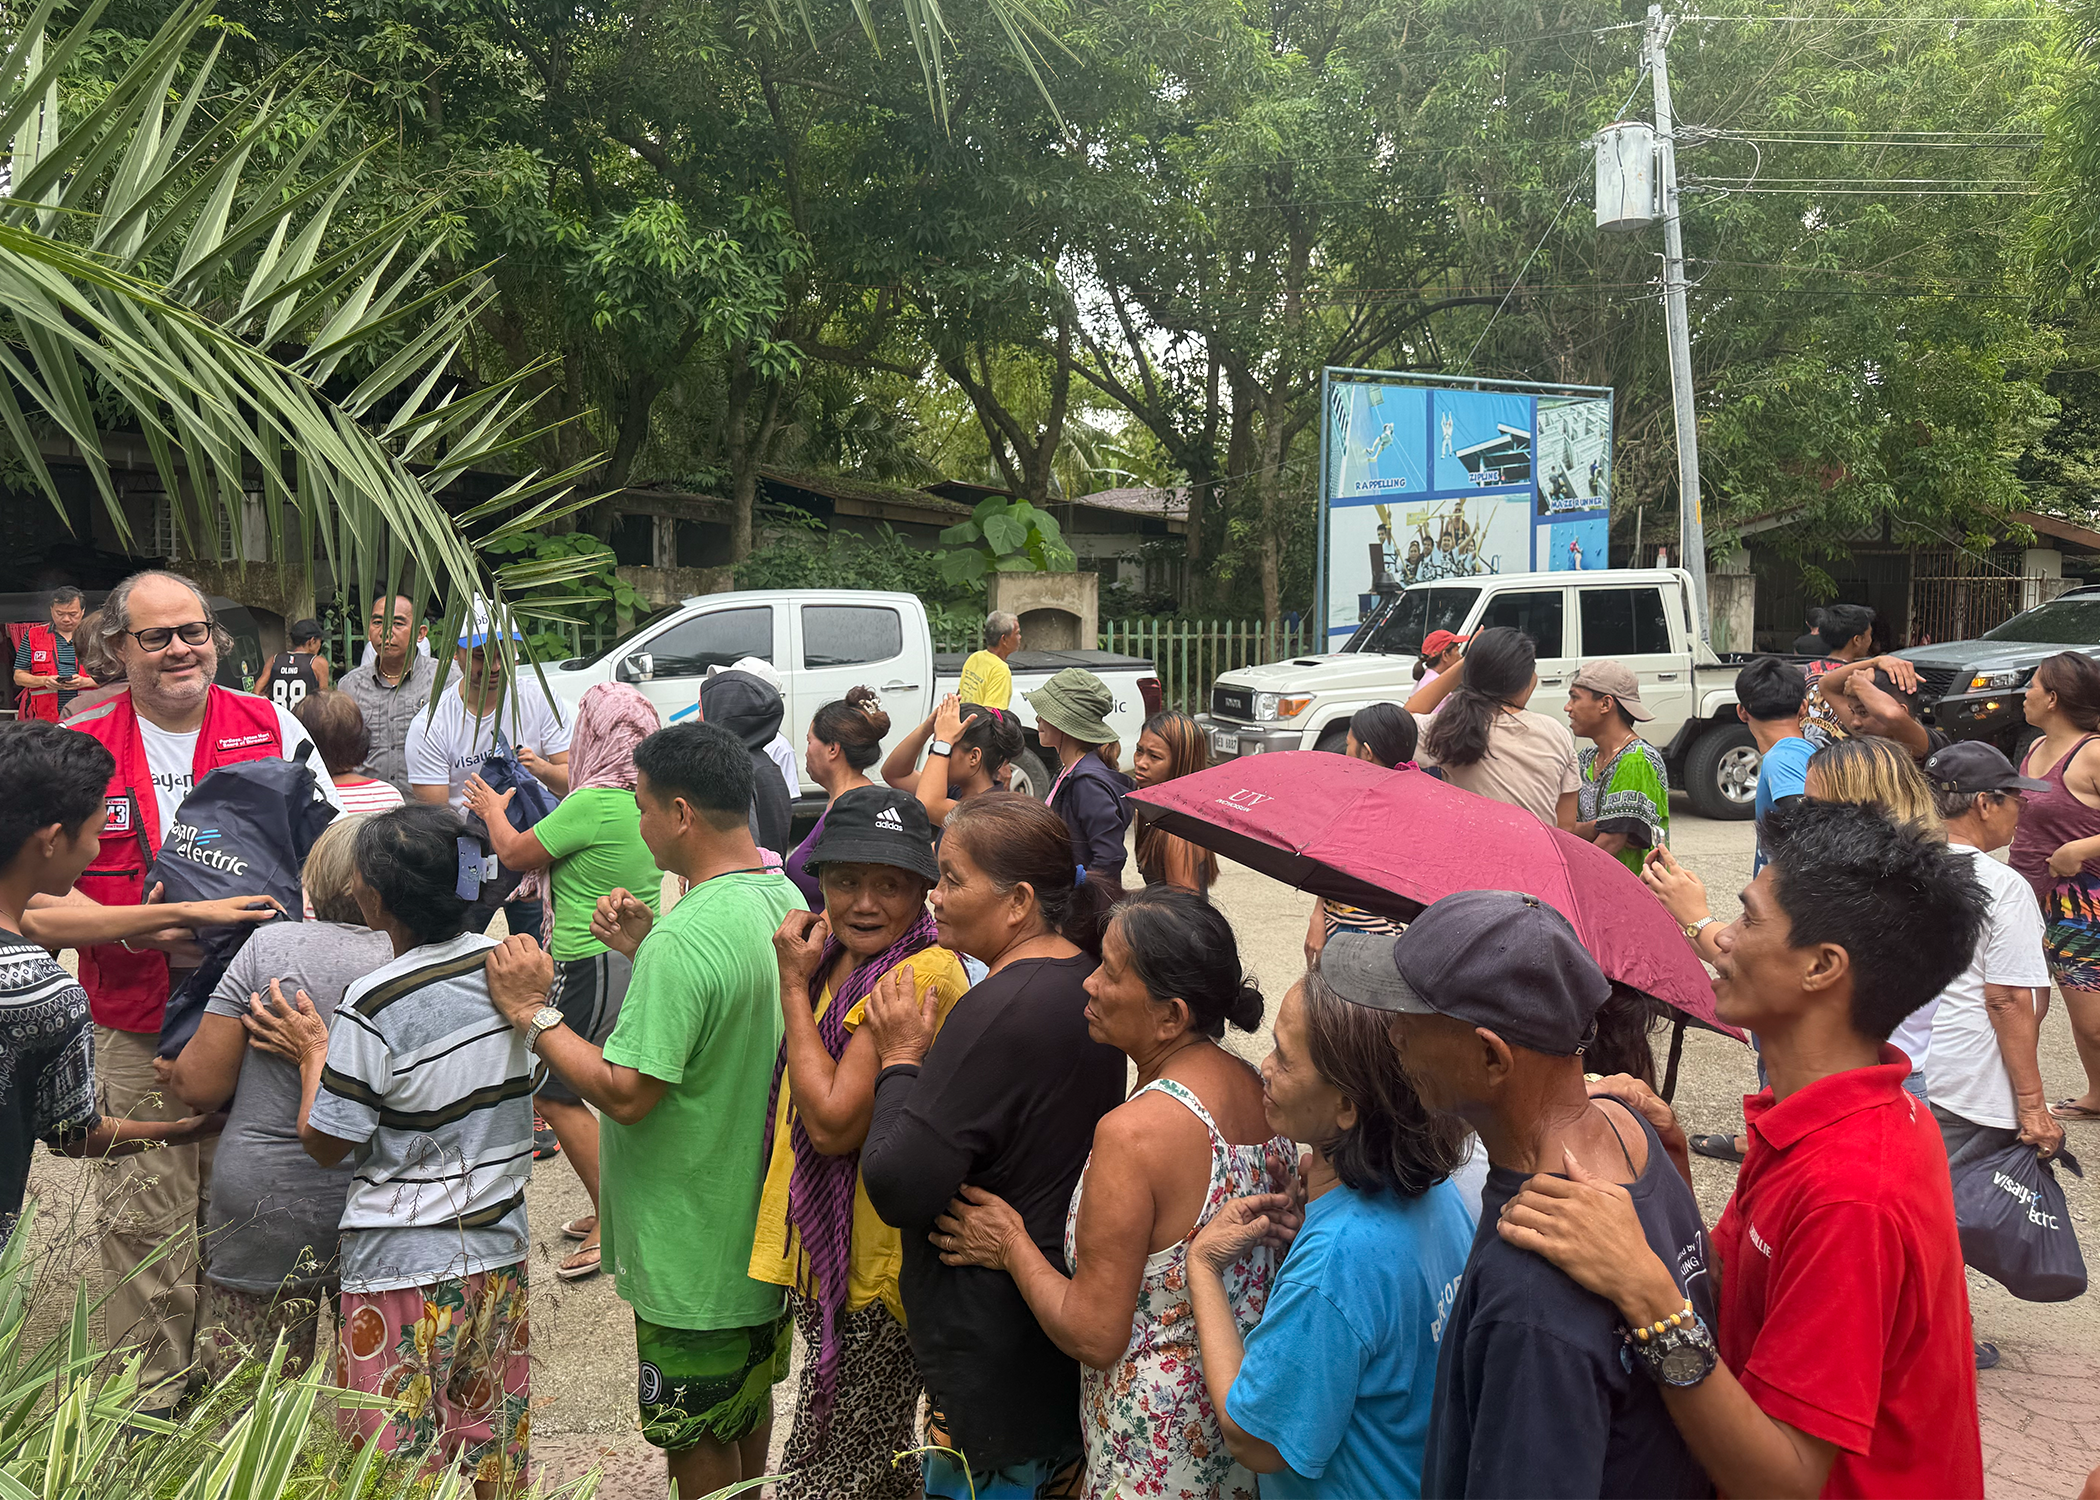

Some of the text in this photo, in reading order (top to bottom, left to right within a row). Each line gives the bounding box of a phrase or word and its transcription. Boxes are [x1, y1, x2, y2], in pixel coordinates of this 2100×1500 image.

[1355, 478, 1406, 490] RAPPELLING
[1468, 471, 1499, 483] ZIPLINE
[1551, 497, 1603, 509] MAZE RUNNER
[151, 772, 194, 792] ayan
[1228, 788, 1275, 806] UV
[106, 805, 126, 824] 43
[875, 820, 903, 832] adidas
[176, 841, 249, 876] electric
